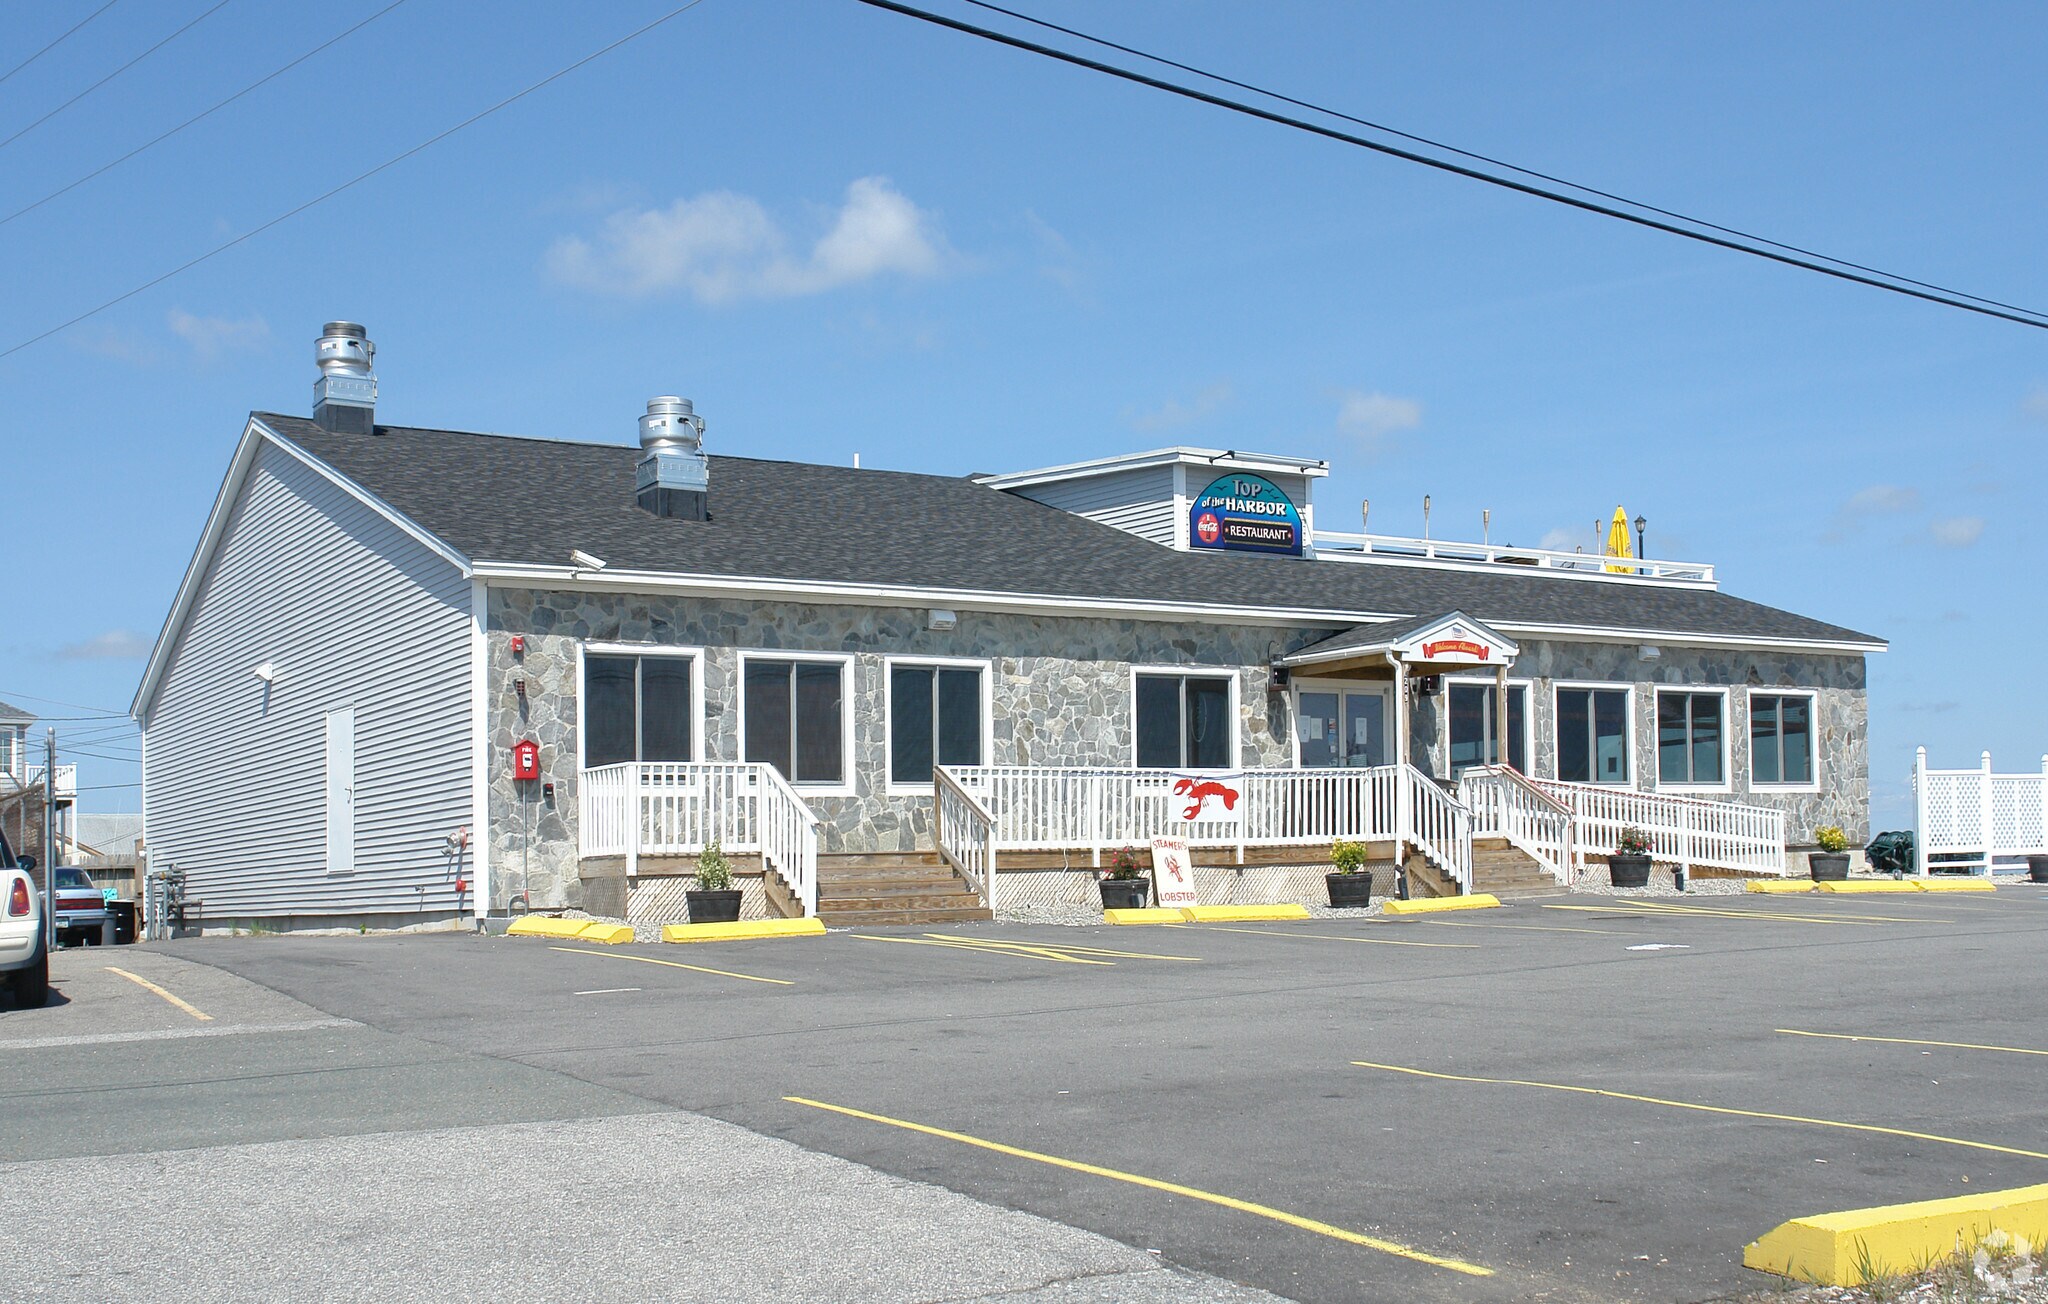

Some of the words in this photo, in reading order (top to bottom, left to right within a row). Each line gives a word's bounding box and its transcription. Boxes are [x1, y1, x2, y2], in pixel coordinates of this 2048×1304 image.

[1201, 496, 1211, 507] of
[1211, 496, 1224, 507] the
[1225, 497, 1286, 516] HARBOR
[1230, 525, 1288, 541] RESTAURANT
[1152, 839, 1187, 851] STEAMERS
[1160, 892, 1196, 902] LOBSTER
